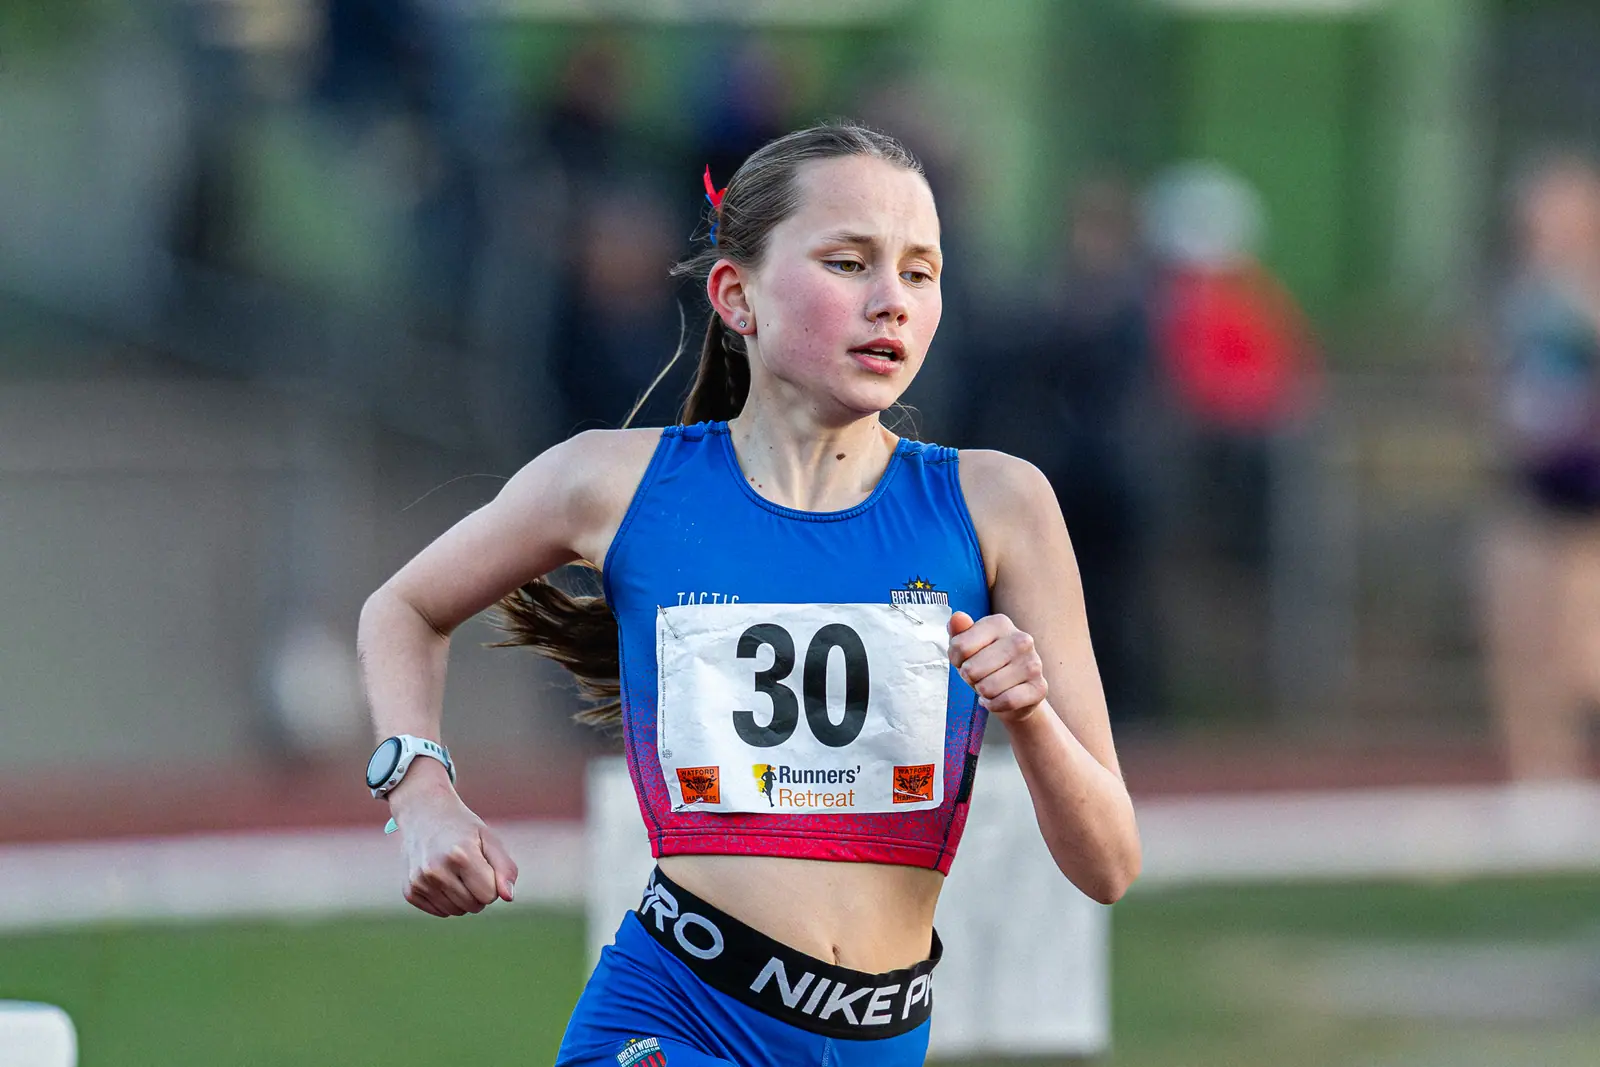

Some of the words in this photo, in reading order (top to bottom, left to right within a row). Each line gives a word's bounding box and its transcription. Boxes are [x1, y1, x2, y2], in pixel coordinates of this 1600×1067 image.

[891, 590, 949, 606] BRENTWOOD
[732, 623, 870, 748] 30
[680, 768, 715, 777] WATFORD
[897, 766, 931, 775] WATFORD
[686, 794, 718, 802] HAIERS
[779, 788, 856, 807] Retreat
[749, 956, 901, 1026] NIKE
[617, 1037, 659, 1064] BRENTWOOD
